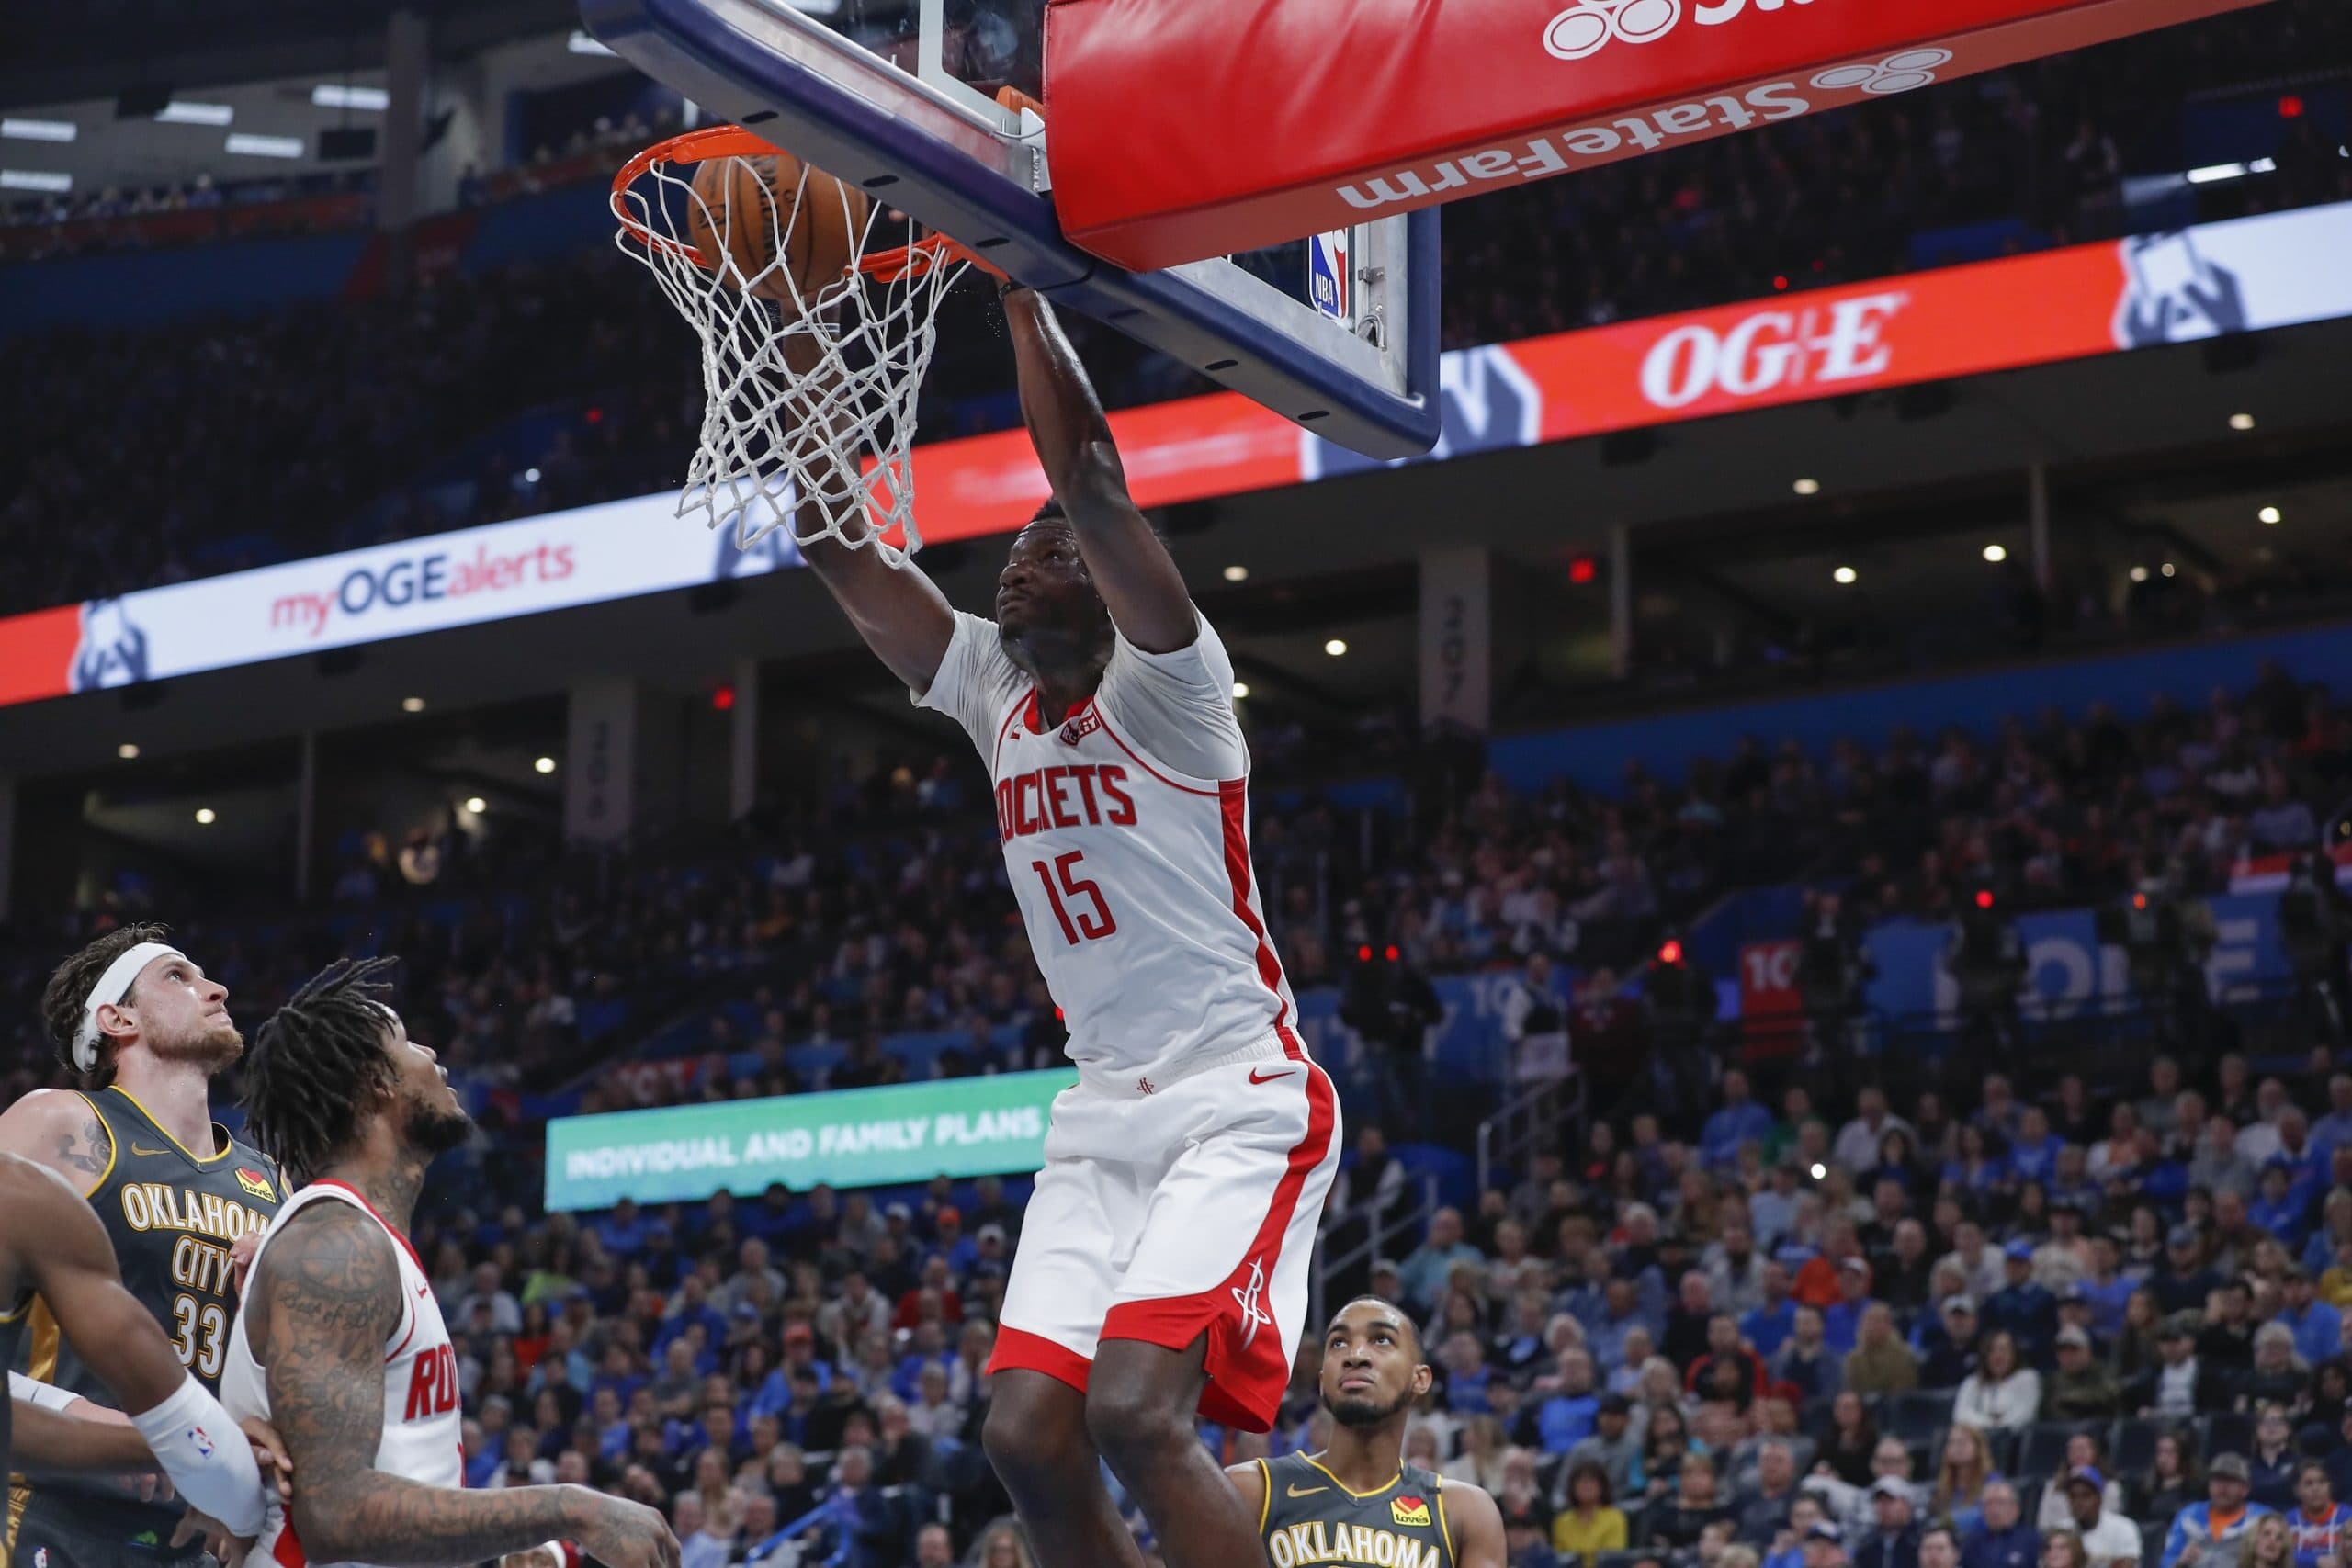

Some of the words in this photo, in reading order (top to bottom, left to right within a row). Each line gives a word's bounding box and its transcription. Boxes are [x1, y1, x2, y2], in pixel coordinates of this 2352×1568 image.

[1315, 272, 1334, 307] NBA
[995, 763, 1138, 846] OCKETS
[1031, 849, 1117, 946] 15
[566, 1140, 737, 1181] INDIVIDUAL
[744, 1127, 811, 1162] AND
[819, 1115, 930, 1156] FAMILY
[935, 1106, 1043, 1145] PLANS
[121, 1182, 270, 1243] OKLAHOM
[172, 1235, 237, 1297] CITY
[170, 1293, 227, 1379] 33
[1270, 1521, 1441, 1568] OKLAHOMA
